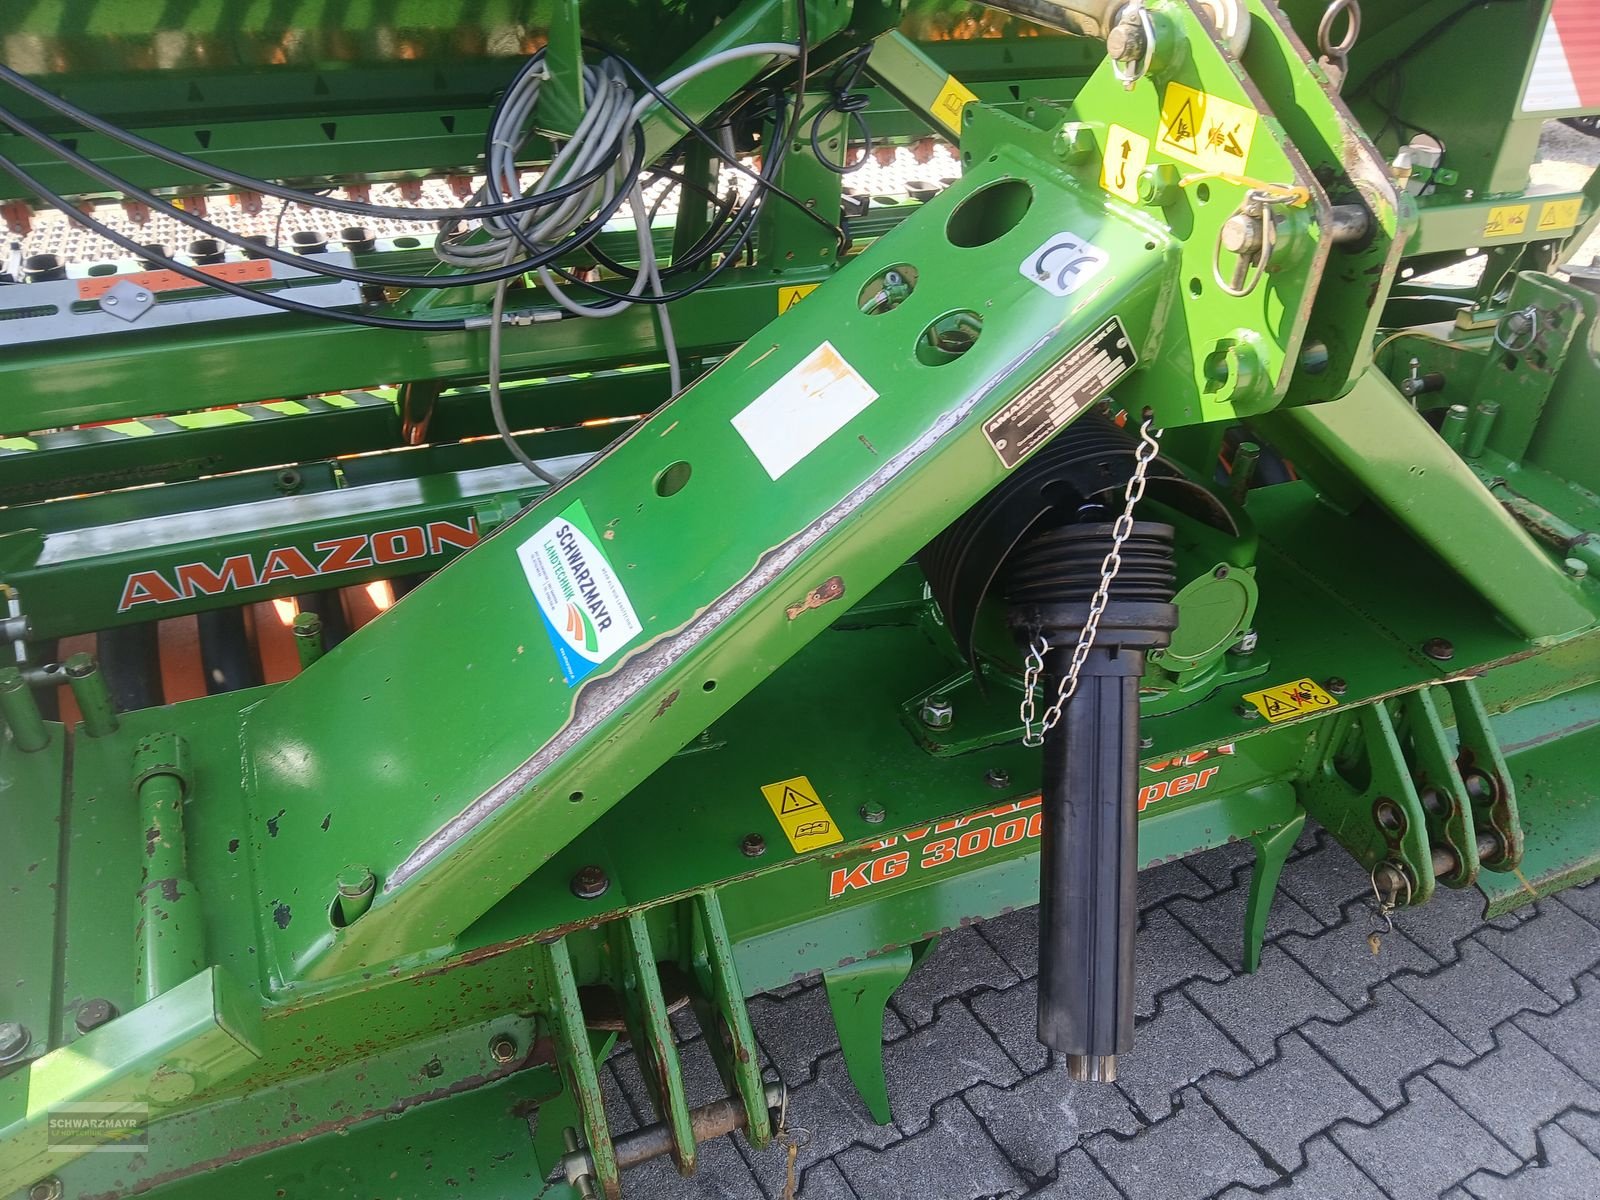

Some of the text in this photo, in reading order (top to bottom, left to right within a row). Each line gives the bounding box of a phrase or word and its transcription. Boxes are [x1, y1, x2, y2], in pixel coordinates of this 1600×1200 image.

[989, 322, 1118, 432] AMAZONEN-WERKE
[543, 539, 577, 602] LANDTECHNIK
[555, 524, 613, 633] SCHWARZMAYR
[829, 851, 910, 897] KG
[1138, 766, 1220, 812] per
